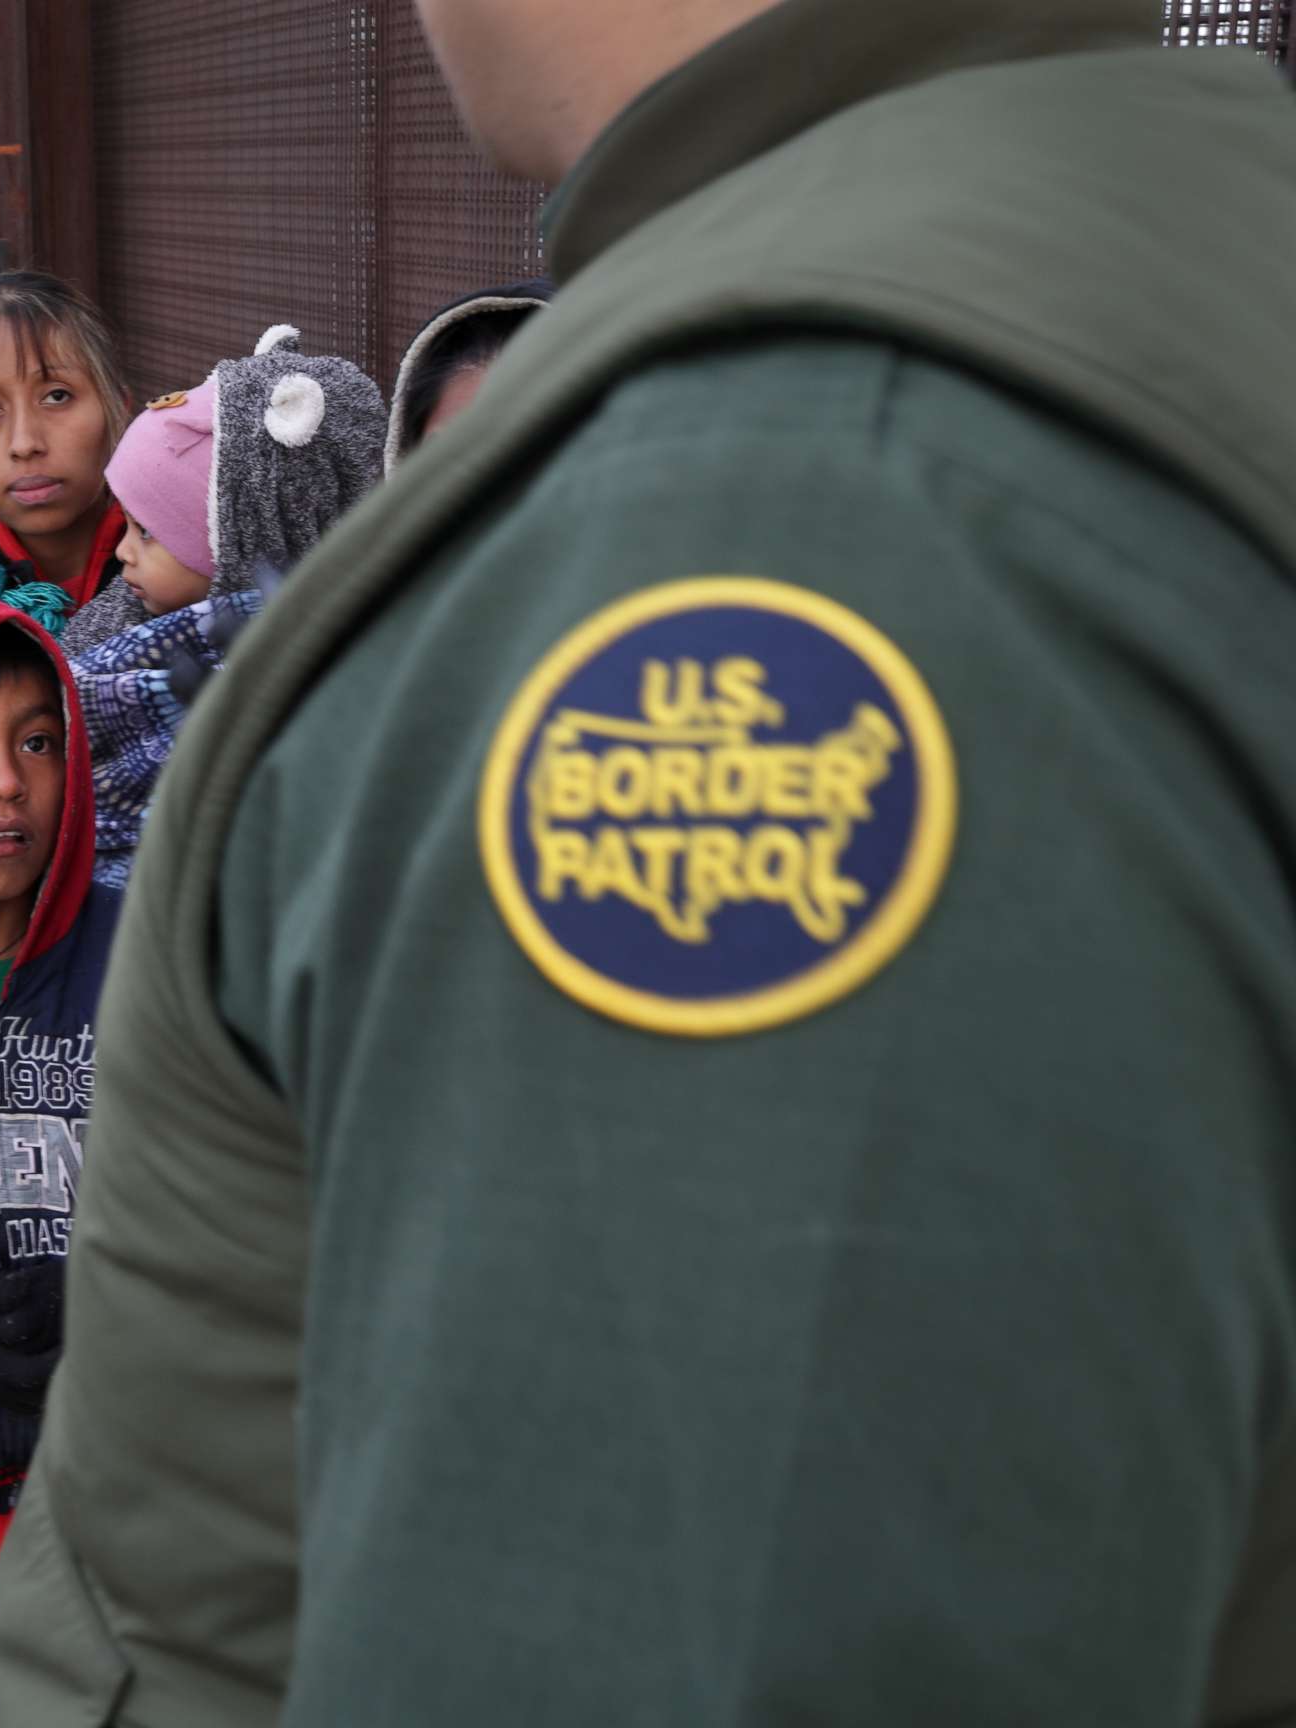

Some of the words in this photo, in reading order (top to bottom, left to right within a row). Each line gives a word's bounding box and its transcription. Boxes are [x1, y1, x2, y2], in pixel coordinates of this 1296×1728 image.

[640, 655, 784, 727] U.S.
[548, 744, 873, 820] BORDER
[538, 823, 866, 905] PATROL
[6, 1217, 76, 1260] COAS
